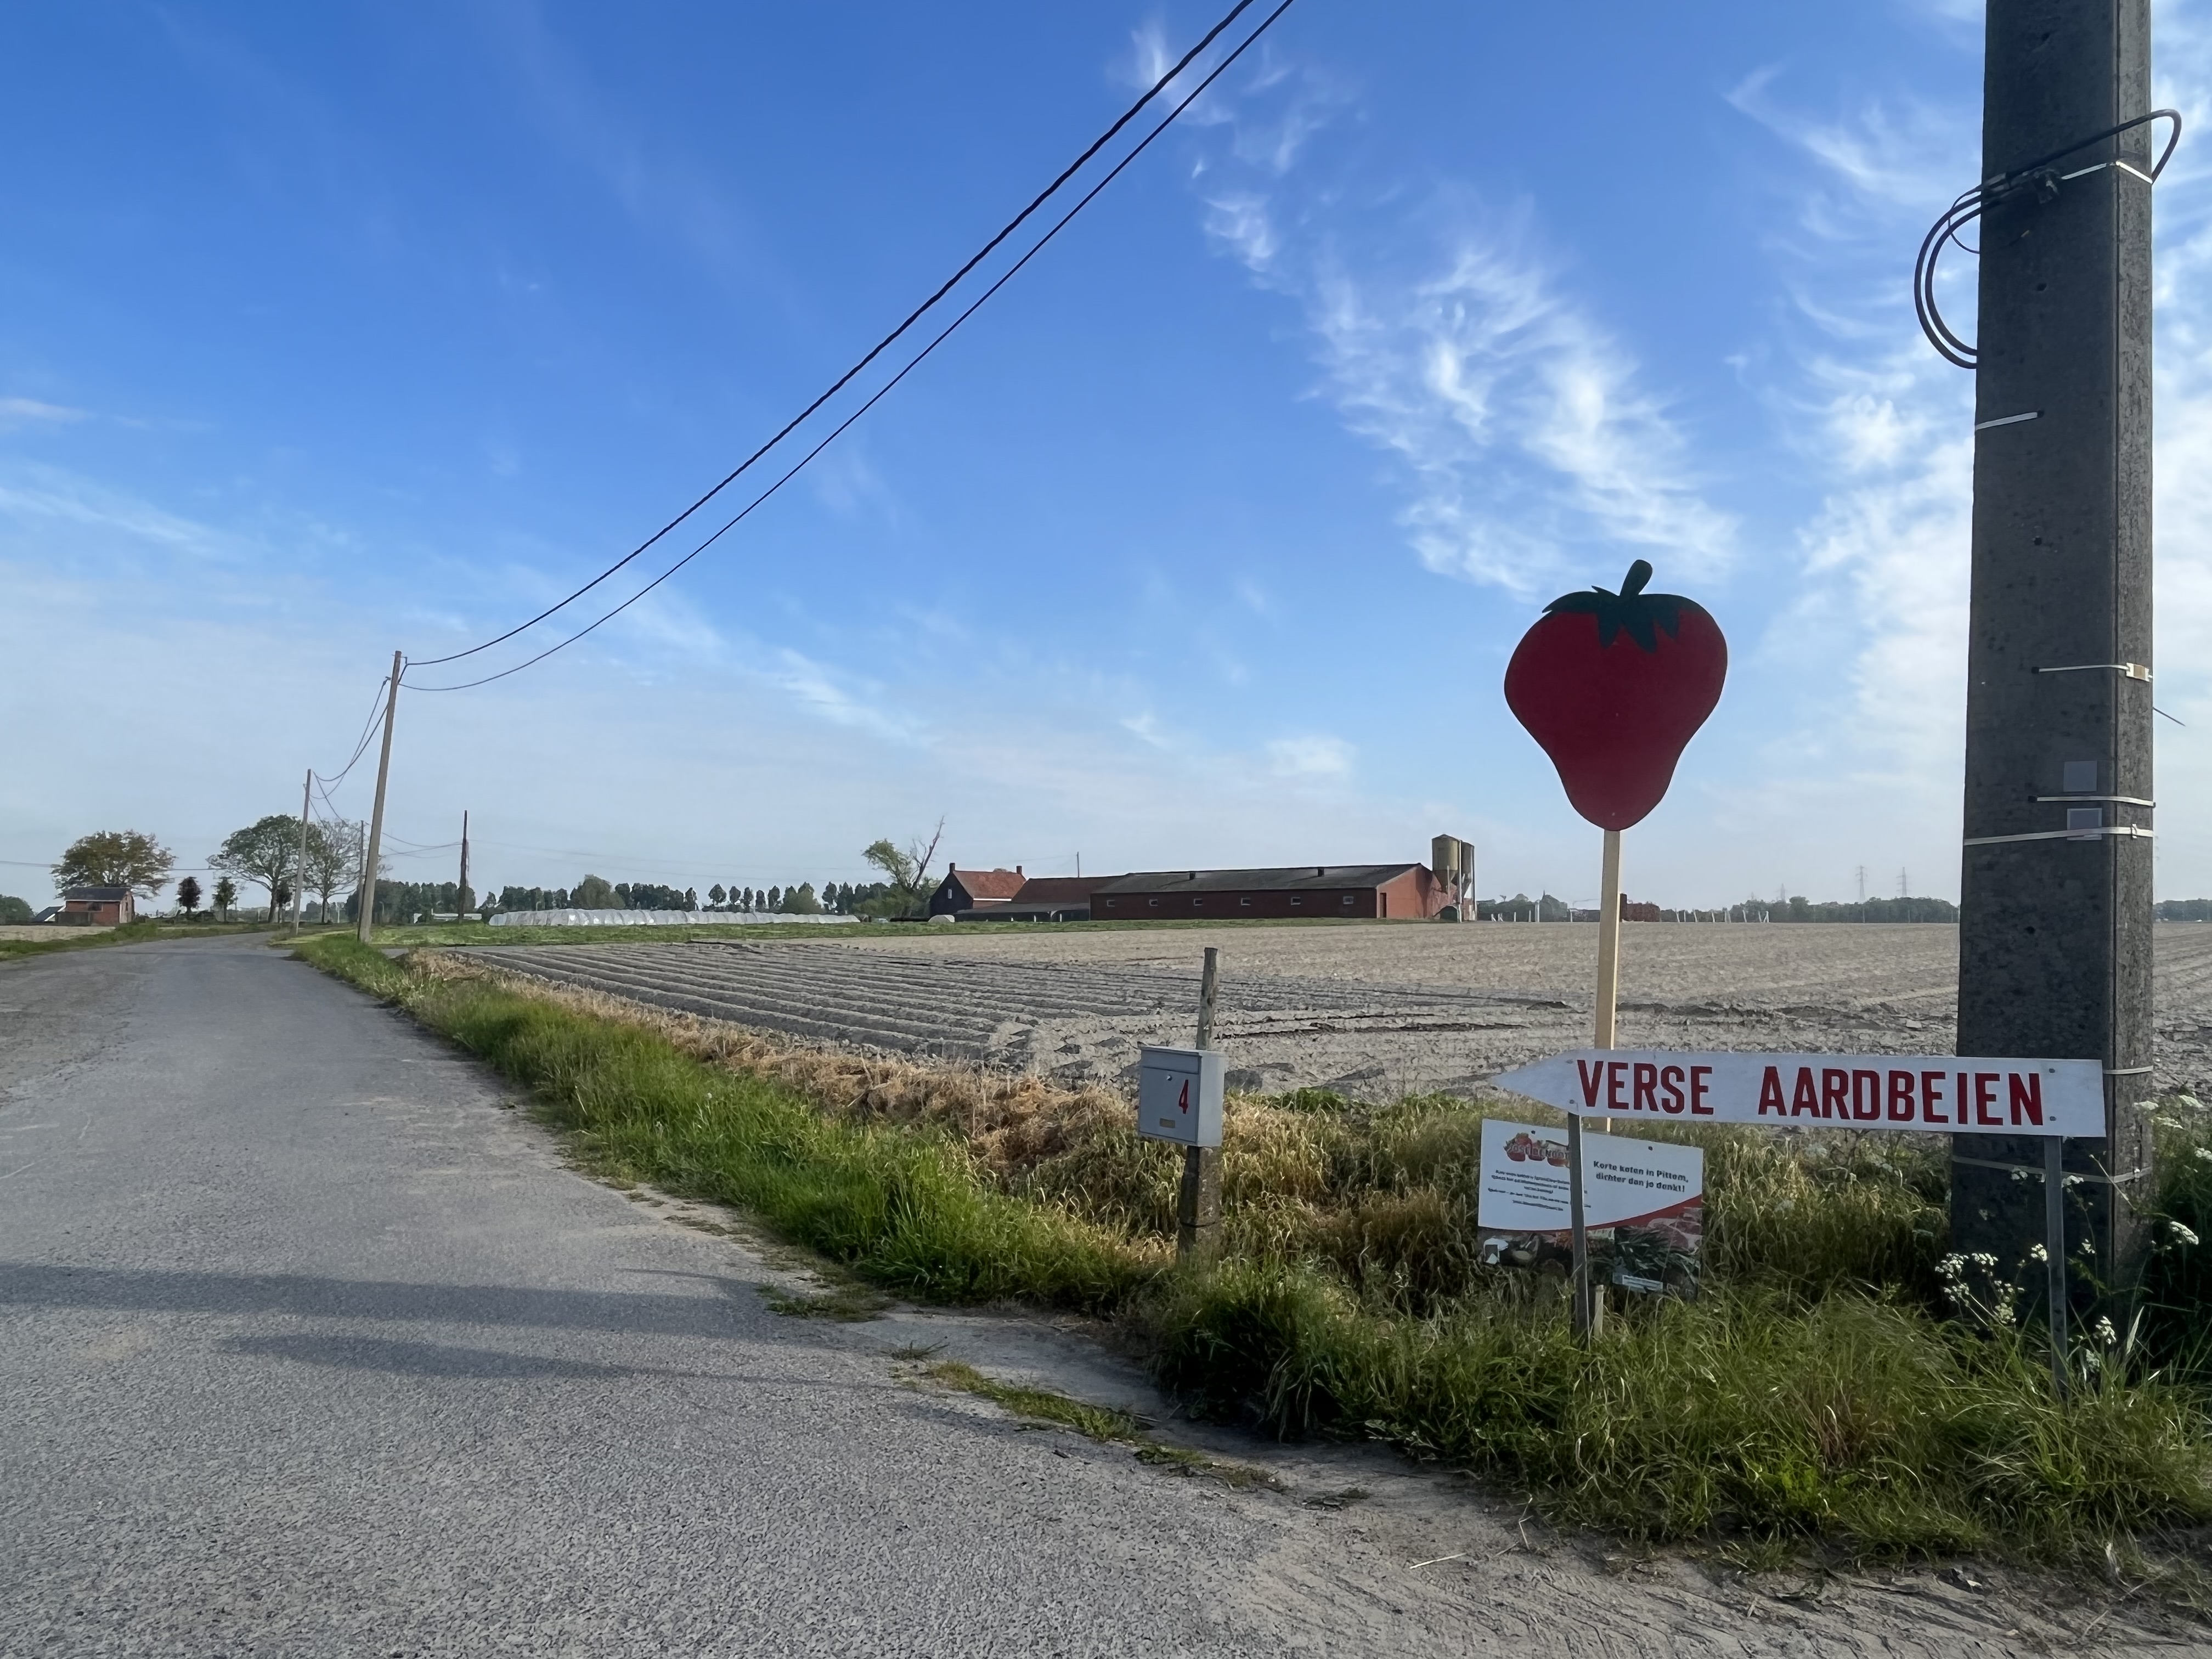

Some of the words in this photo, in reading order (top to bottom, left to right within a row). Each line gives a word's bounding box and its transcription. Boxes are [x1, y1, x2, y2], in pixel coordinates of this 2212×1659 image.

[1179, 1079, 1188, 1114] 4
[1577, 1060, 1714, 1115] VERSE
[1758, 1066, 2044, 1125] AARDBEIEN
[1628, 1178, 1644, 1186] dan
[1646, 1169, 1654, 1177] in
